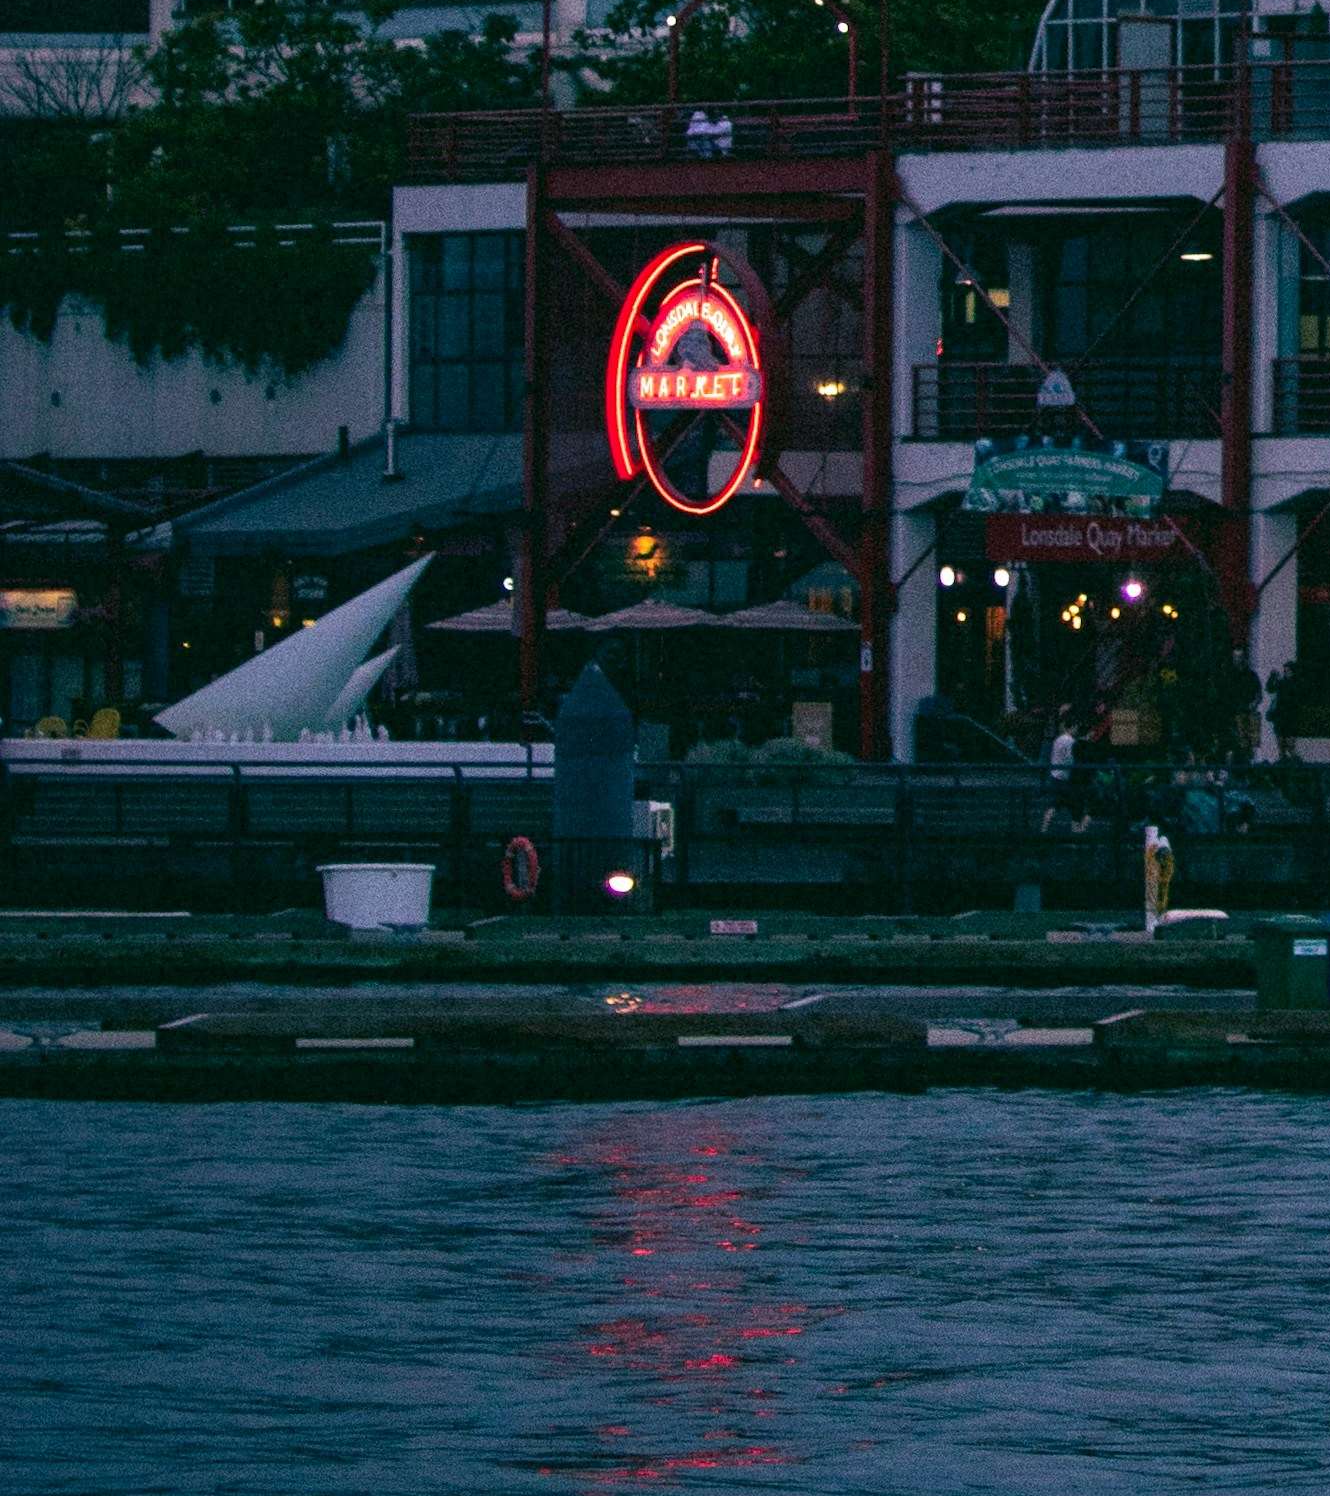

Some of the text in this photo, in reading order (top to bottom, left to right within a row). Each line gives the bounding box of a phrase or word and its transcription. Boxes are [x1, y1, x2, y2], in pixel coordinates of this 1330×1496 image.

[650, 299, 711, 357] LONSDALE
[639, 372, 743, 400] MARKET
[1021, 523, 1083, 546] Lonsdale
[1086, 521, 1123, 556] Quay
